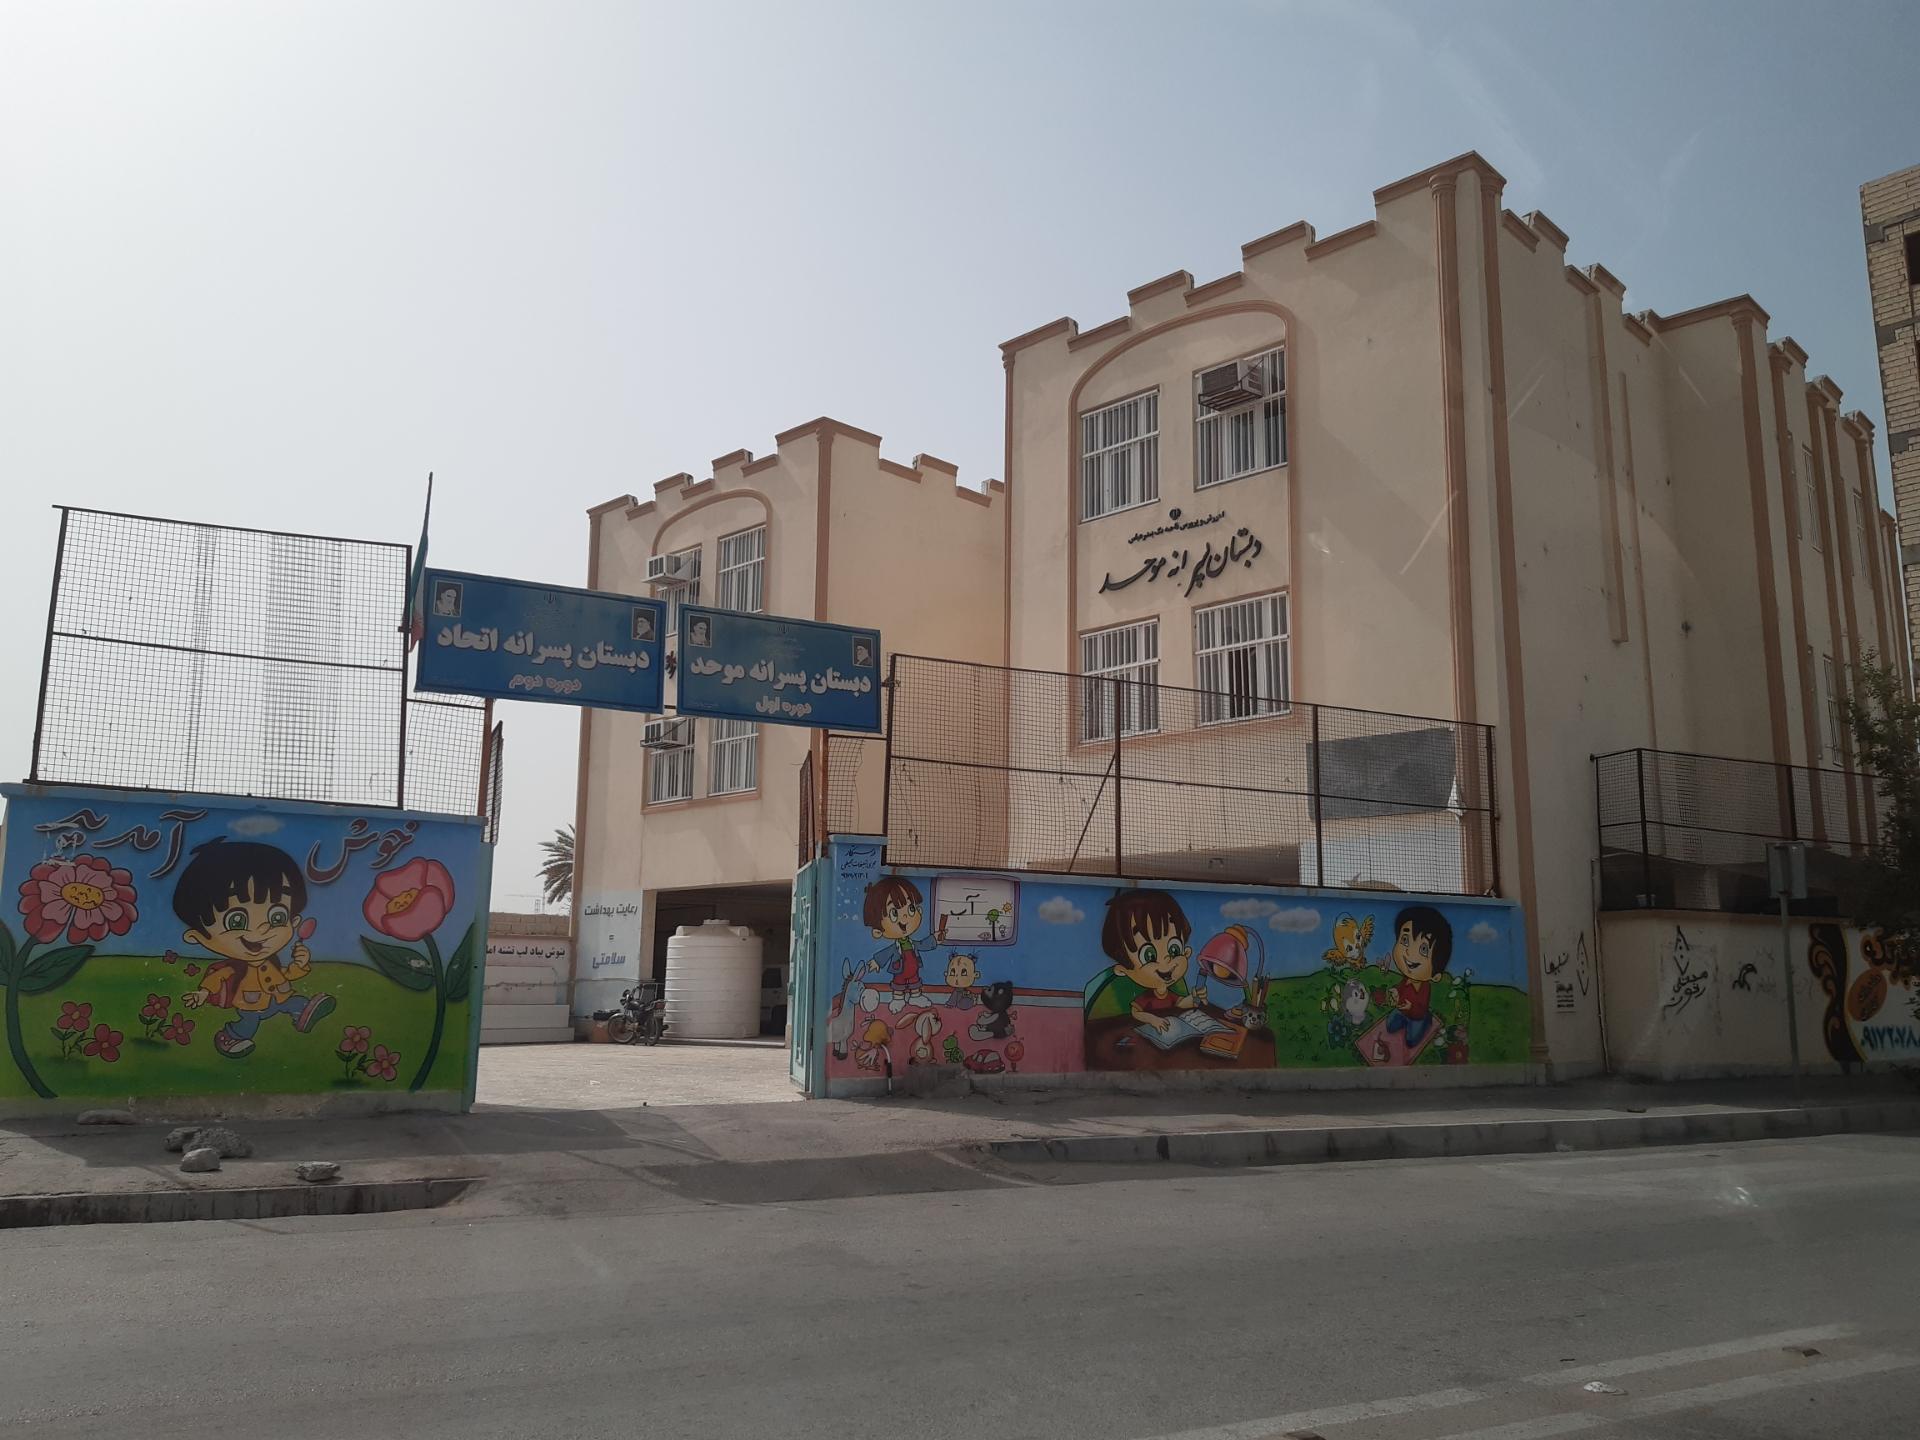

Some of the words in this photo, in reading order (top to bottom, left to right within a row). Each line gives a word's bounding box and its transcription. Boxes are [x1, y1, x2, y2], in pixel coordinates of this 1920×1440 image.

[1206, 527, 1262, 578] دبستان
[1098, 556, 1167, 593] موحد
[1167, 542, 1211, 597] پسرانه
[437, 624, 499, 652] اتحاد
[502, 629, 573, 668] پسرانه
[576, 640, 651, 673] دبستان
[690, 656, 745, 684] موحد
[508, 673, 543, 692] دوم
[545, 677, 582, 694] دوره
[749, 658, 807, 693] پسرانه
[810, 666, 872, 698] دبستان
[755, 695, 781, 714] اول
[781, 701, 812, 718] دوره
[304, 817, 417, 884] خوش
[584, 904, 615, 917] بهداشت
[616, 903, 638, 917] رعایت
[592, 952, 626, 969] سلامتی
